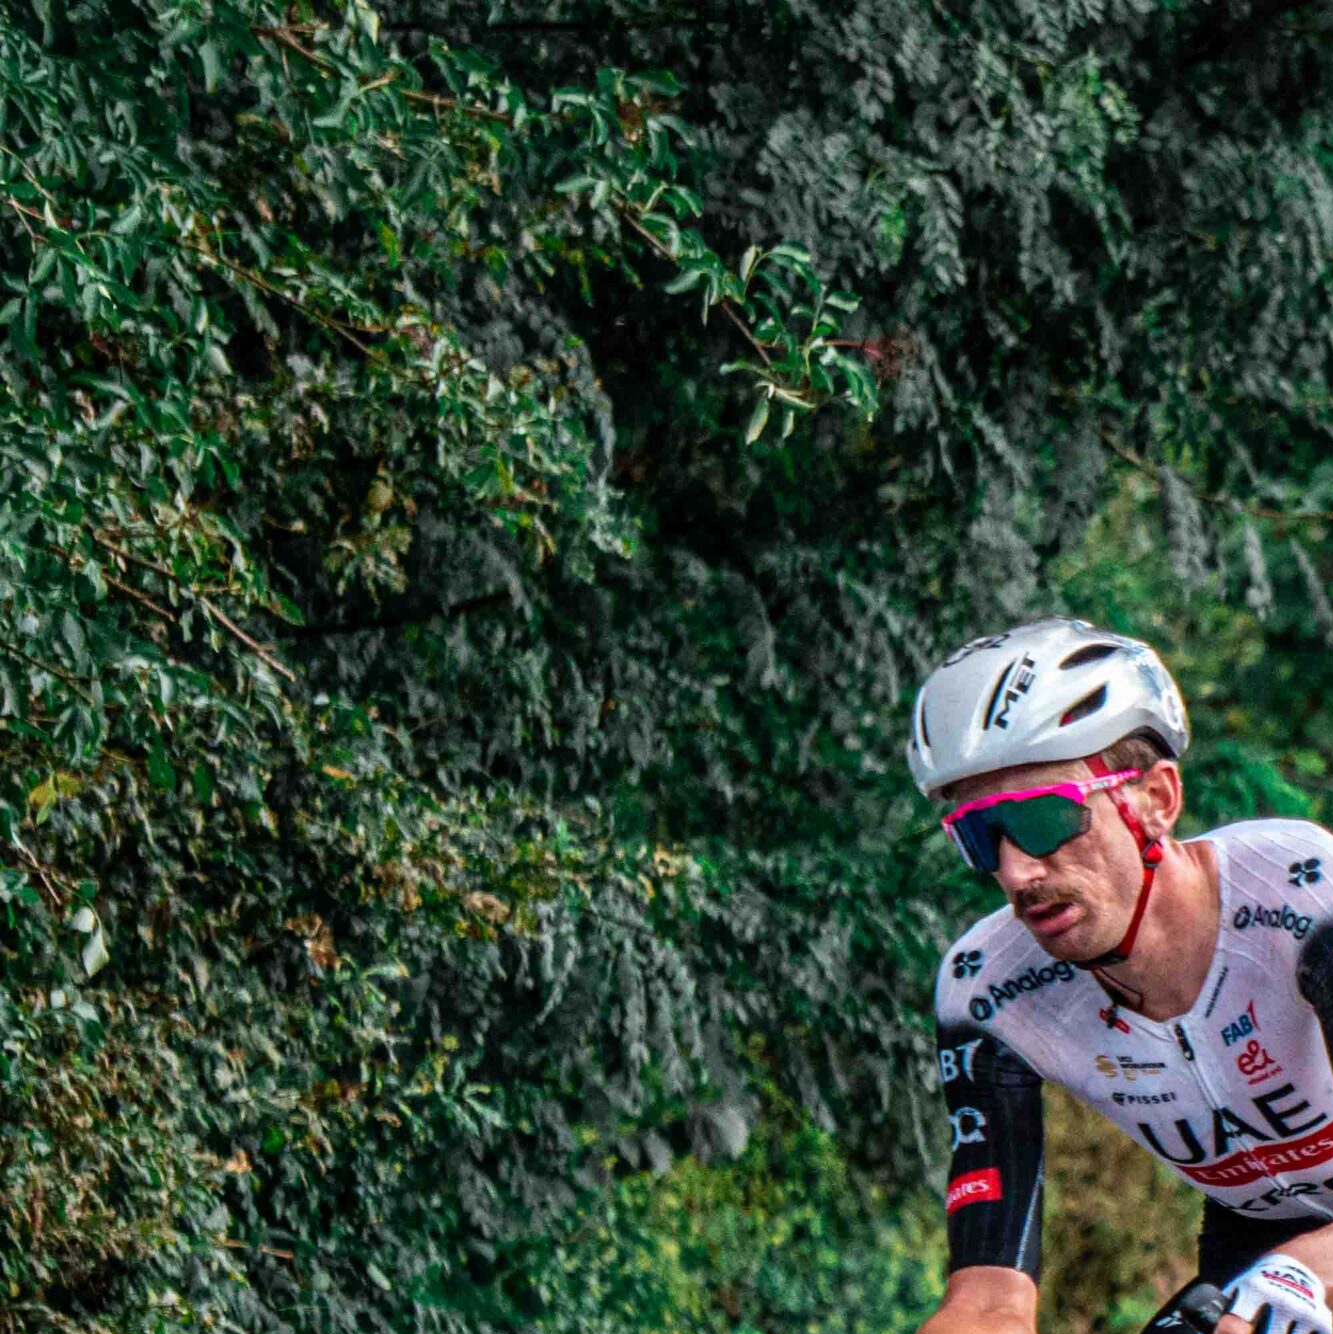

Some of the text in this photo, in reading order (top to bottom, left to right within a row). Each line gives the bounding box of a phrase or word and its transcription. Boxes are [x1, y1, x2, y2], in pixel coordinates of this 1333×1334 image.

[993, 652, 1035, 730] MET
[1252, 904, 1313, 940] Analog
[988, 960, 1076, 1008] Analog
[1137, 1083, 1329, 1165] UAE
